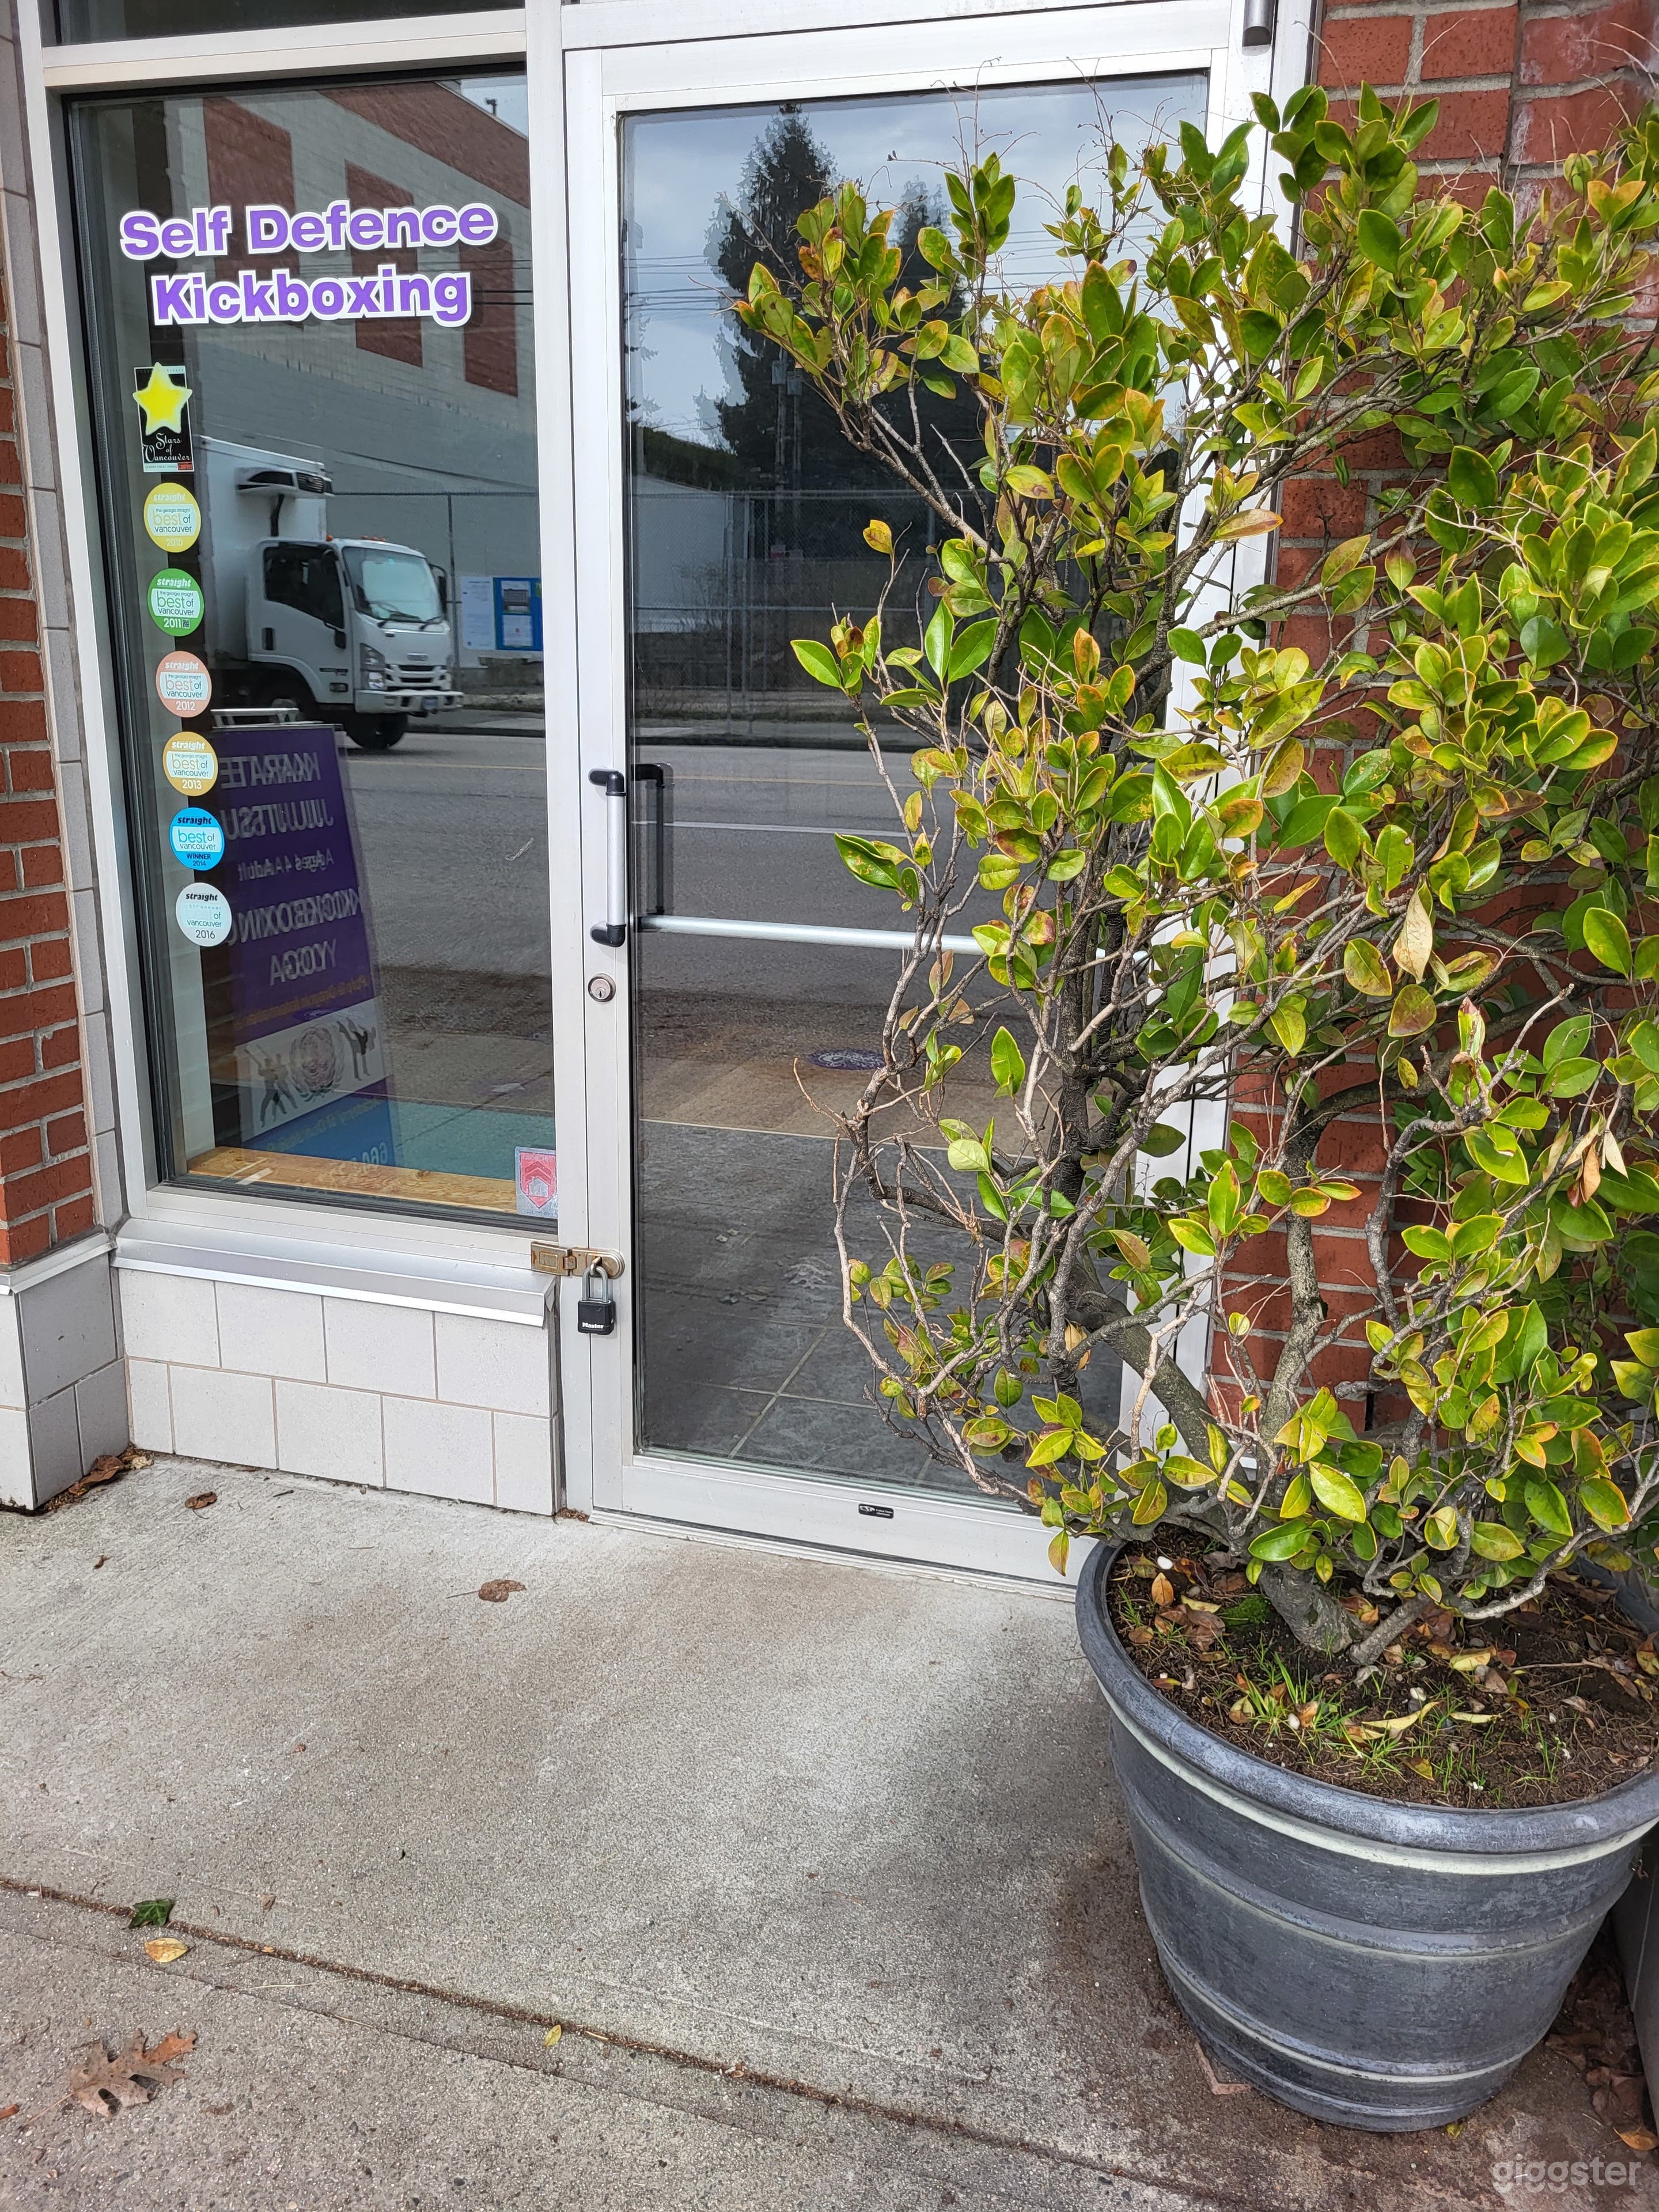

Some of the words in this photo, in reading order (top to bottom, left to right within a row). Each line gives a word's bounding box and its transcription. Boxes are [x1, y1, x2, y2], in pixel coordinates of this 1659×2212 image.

[120, 206, 233, 260] Self
[245, 200, 498, 255] Defence
[150, 264, 472, 328] Kickboxing
[156, 433, 181, 450] Stars
[142, 444, 191, 462] Vancouver
[165, 444, 173, 456] of
[152, 508, 182, 525] best
[183, 514, 191, 523] of
[157, 578, 191, 588] straight
[157, 590, 185, 608] best
[186, 599, 194, 607] of
[158, 608, 195, 616] vancouver
[164, 618, 181, 628] 2011
[165, 661, 199, 671] straight
[165, 674, 194, 691] best
[194, 681, 202, 690] of
[176, 700, 196, 711] 2012
[172, 741, 205, 751] straight
[171, 753, 200, 770] best
[200, 760, 208, 769] of
[181, 779, 202, 789] 2013
[177, 817, 212, 825] straight
[178, 828, 206, 843] best
[207, 833, 215, 842] of
[185, 893, 218, 902] straight
[214, 911, 221, 920] of
[187, 919, 222, 927] vancouver
[196, 929, 215, 939] 2016
